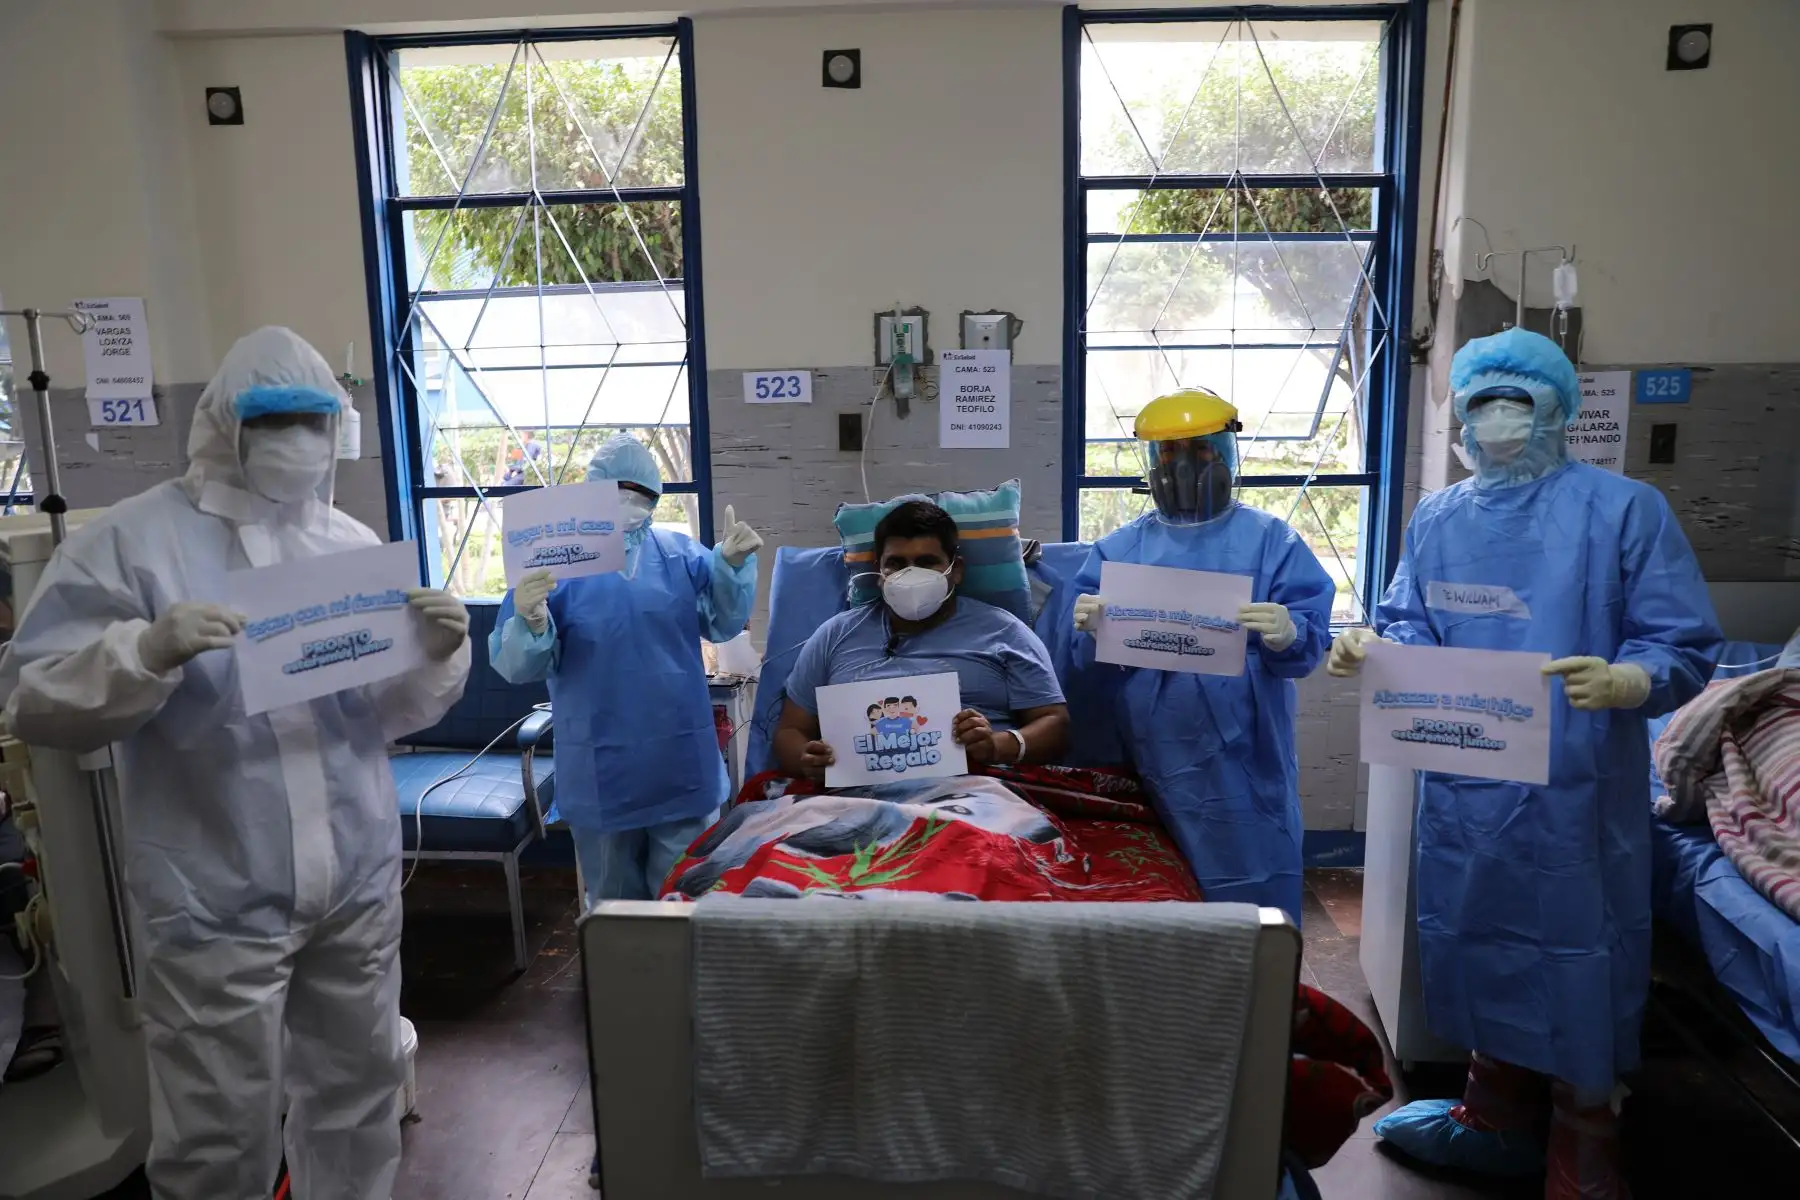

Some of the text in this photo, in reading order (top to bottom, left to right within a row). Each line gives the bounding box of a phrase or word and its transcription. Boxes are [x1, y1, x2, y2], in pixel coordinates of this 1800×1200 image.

[95, 327, 131, 336] VARGAS
[99, 338, 132, 346] LOAYZA
[102, 348, 131, 356] JORGE
[755, 376, 802, 399] 523
[960, 385, 991, 393] BORJA
[1601, 388, 1616, 396] 525
[1645, 376, 1681, 396] 525
[955, 395, 996, 403] RAMIREZ
[102, 399, 145, 422] 521
[956, 405, 995, 413] TEOFILO
[950, 423, 967, 431] DNI:
[556, 517, 576, 536] mi
[578, 521, 615, 535] casa
[535, 543, 583, 560] PRONTO
[567, 552, 600, 565] juntos
[295, 605, 328, 626] con
[330, 595, 350, 619] mi
[1105, 605, 1158, 621] Abrazar
[1168, 609, 1193, 625] mis
[1191, 614, 1240, 634] padres
[302, 629, 372, 659] PRONTO
[1123, 638, 1215, 656] estaremos juntos
[1141, 629, 1198, 646] PRONTO
[282, 638, 393, 675] estaremos juntos
[1372, 690, 1437, 709] Abrazar
[1454, 693, 1486, 713] mis
[1485, 696, 1534, 721] hijos
[1412, 717, 1483, 737] PRONTO
[853, 730, 942, 754] El Mejor
[1391, 730, 1507, 750] estaremos juntos
[865, 747, 942, 773] Regalo
